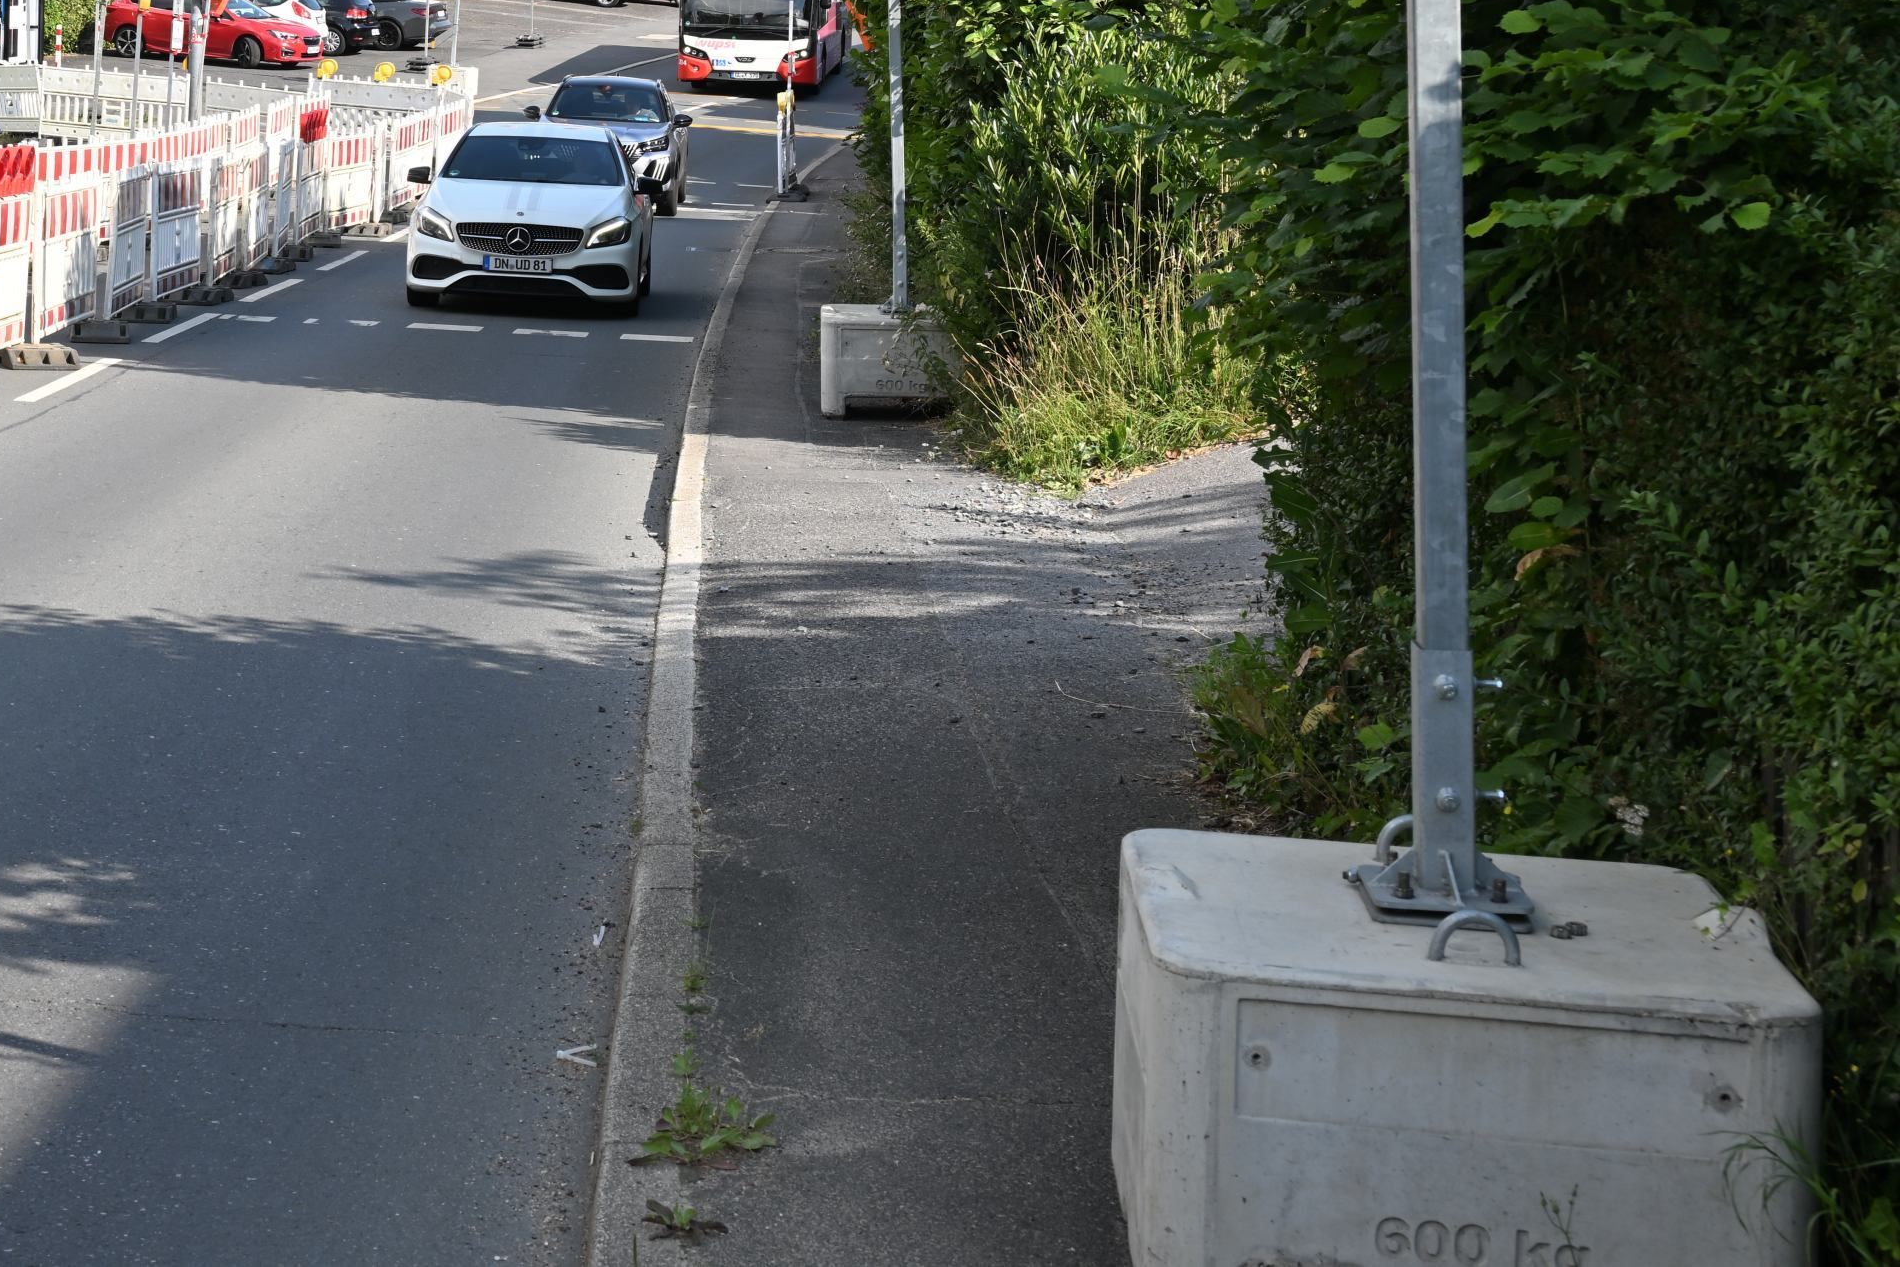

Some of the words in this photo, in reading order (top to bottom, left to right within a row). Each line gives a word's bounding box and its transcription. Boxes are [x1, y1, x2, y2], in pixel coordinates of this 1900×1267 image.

[494, 257, 509, 270] DN
[515, 259, 531, 271] UD
[533, 260, 547, 271] 81
[876, 379, 903, 392] 600
[1374, 1215, 1492, 1267] 600
